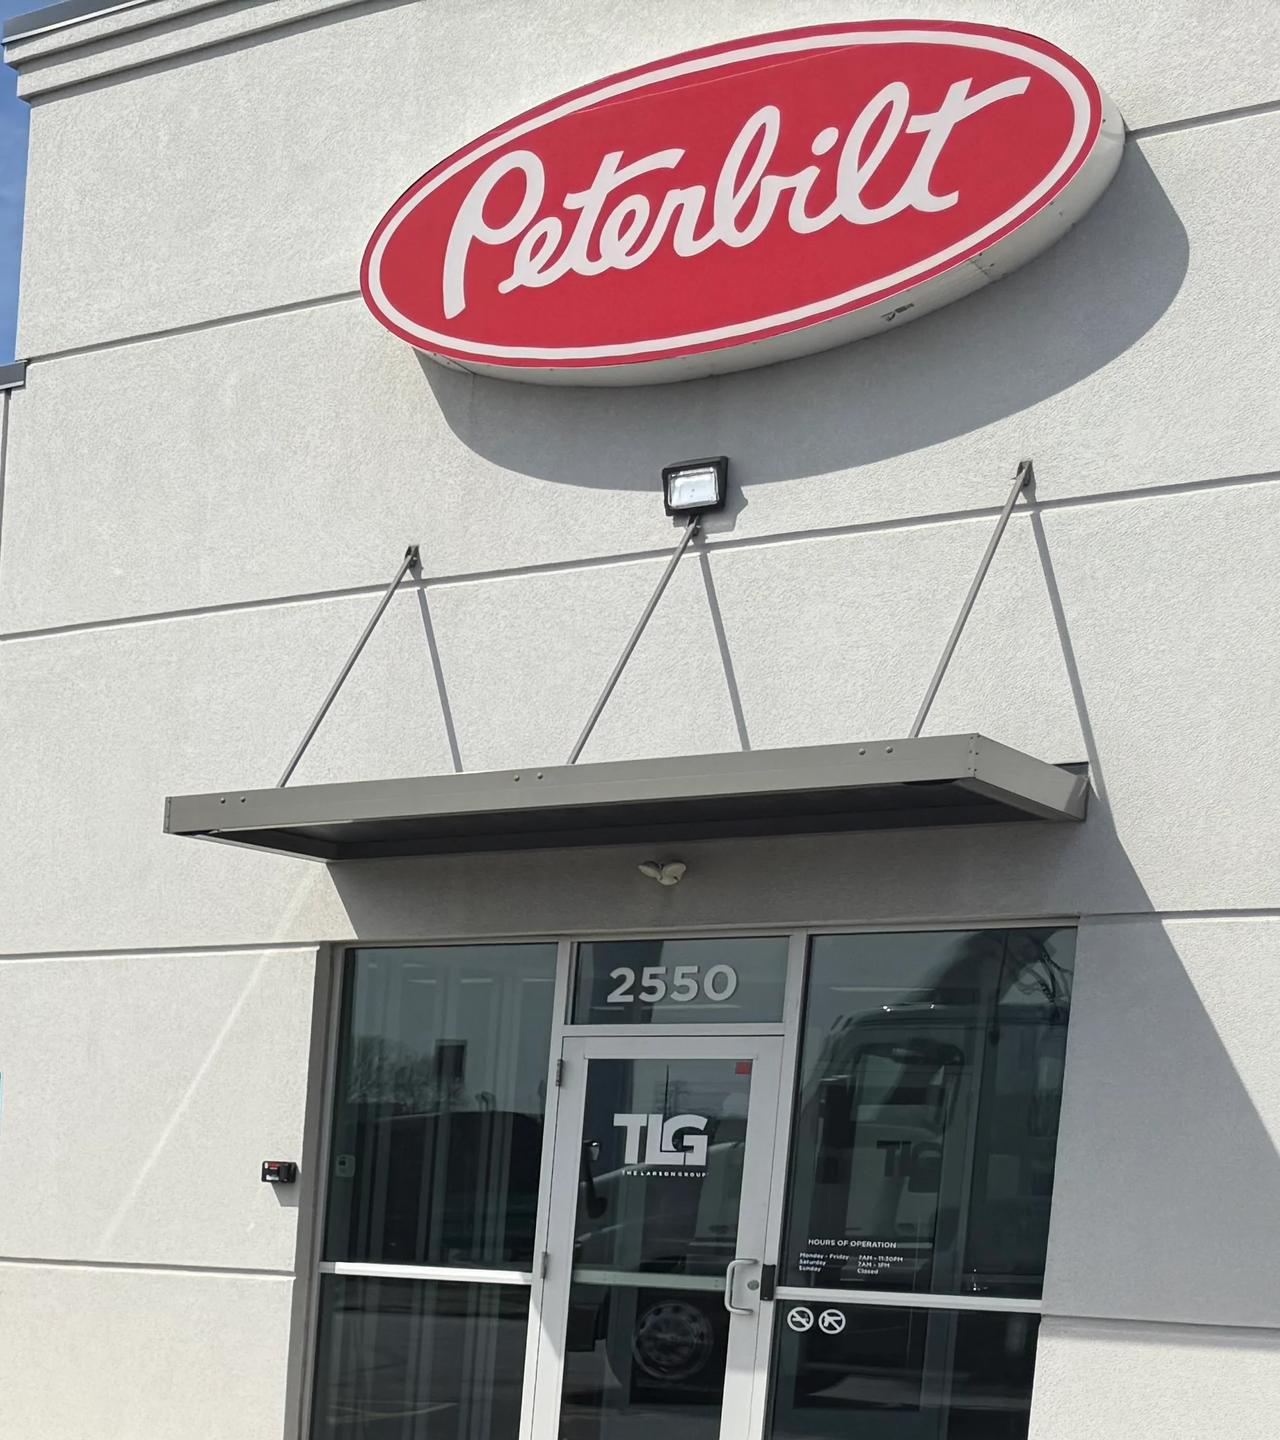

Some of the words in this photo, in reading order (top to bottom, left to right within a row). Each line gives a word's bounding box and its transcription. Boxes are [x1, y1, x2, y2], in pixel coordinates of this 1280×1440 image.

[443, 76, 1031, 319] Peterbilt
[606, 963, 739, 1004] 2550
[613, 1113, 708, 1166] TLG
[829, 1253, 850, 1261] Friday
